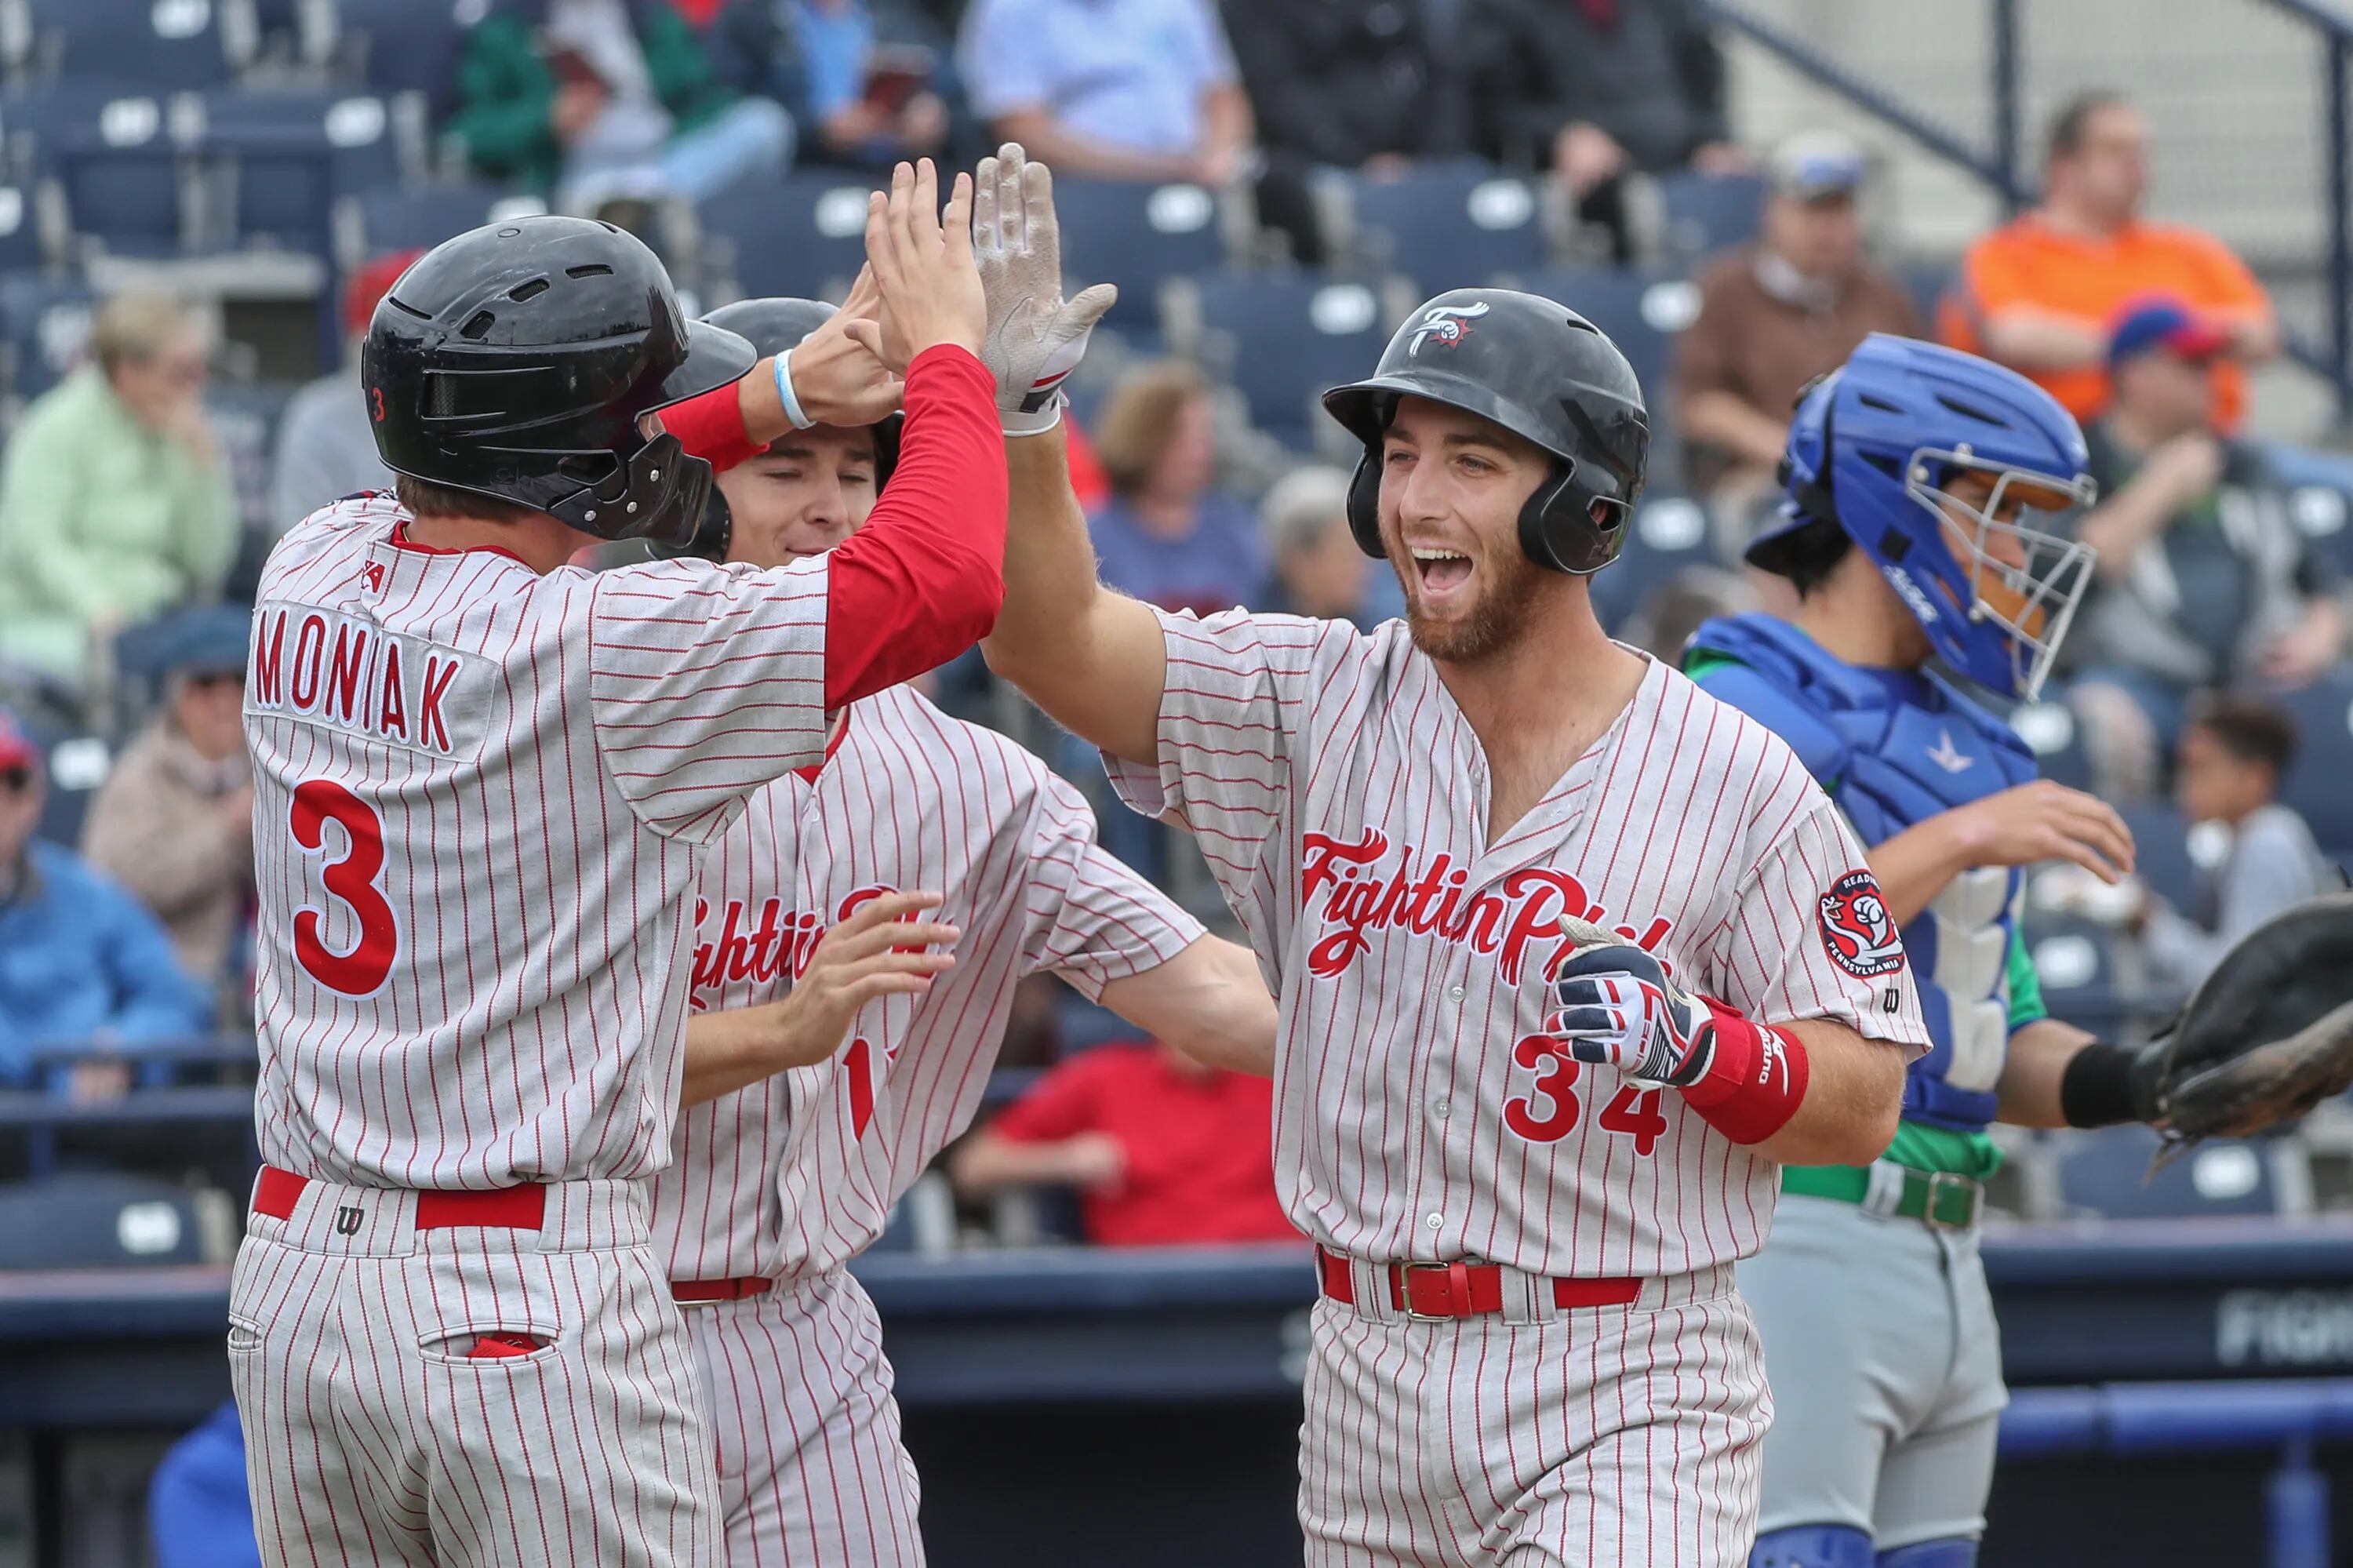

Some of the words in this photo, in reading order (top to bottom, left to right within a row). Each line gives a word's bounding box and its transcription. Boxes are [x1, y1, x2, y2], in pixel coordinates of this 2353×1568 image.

[372, 387, 385, 422] 3
[255, 606, 464, 755] MONIAK
[287, 775, 403, 1001] 3
[1301, 825, 1500, 980] Fightin
[1827, 940, 1900, 975] PENNSYLVANIA
[1500, 1031, 1669, 1158] 34
